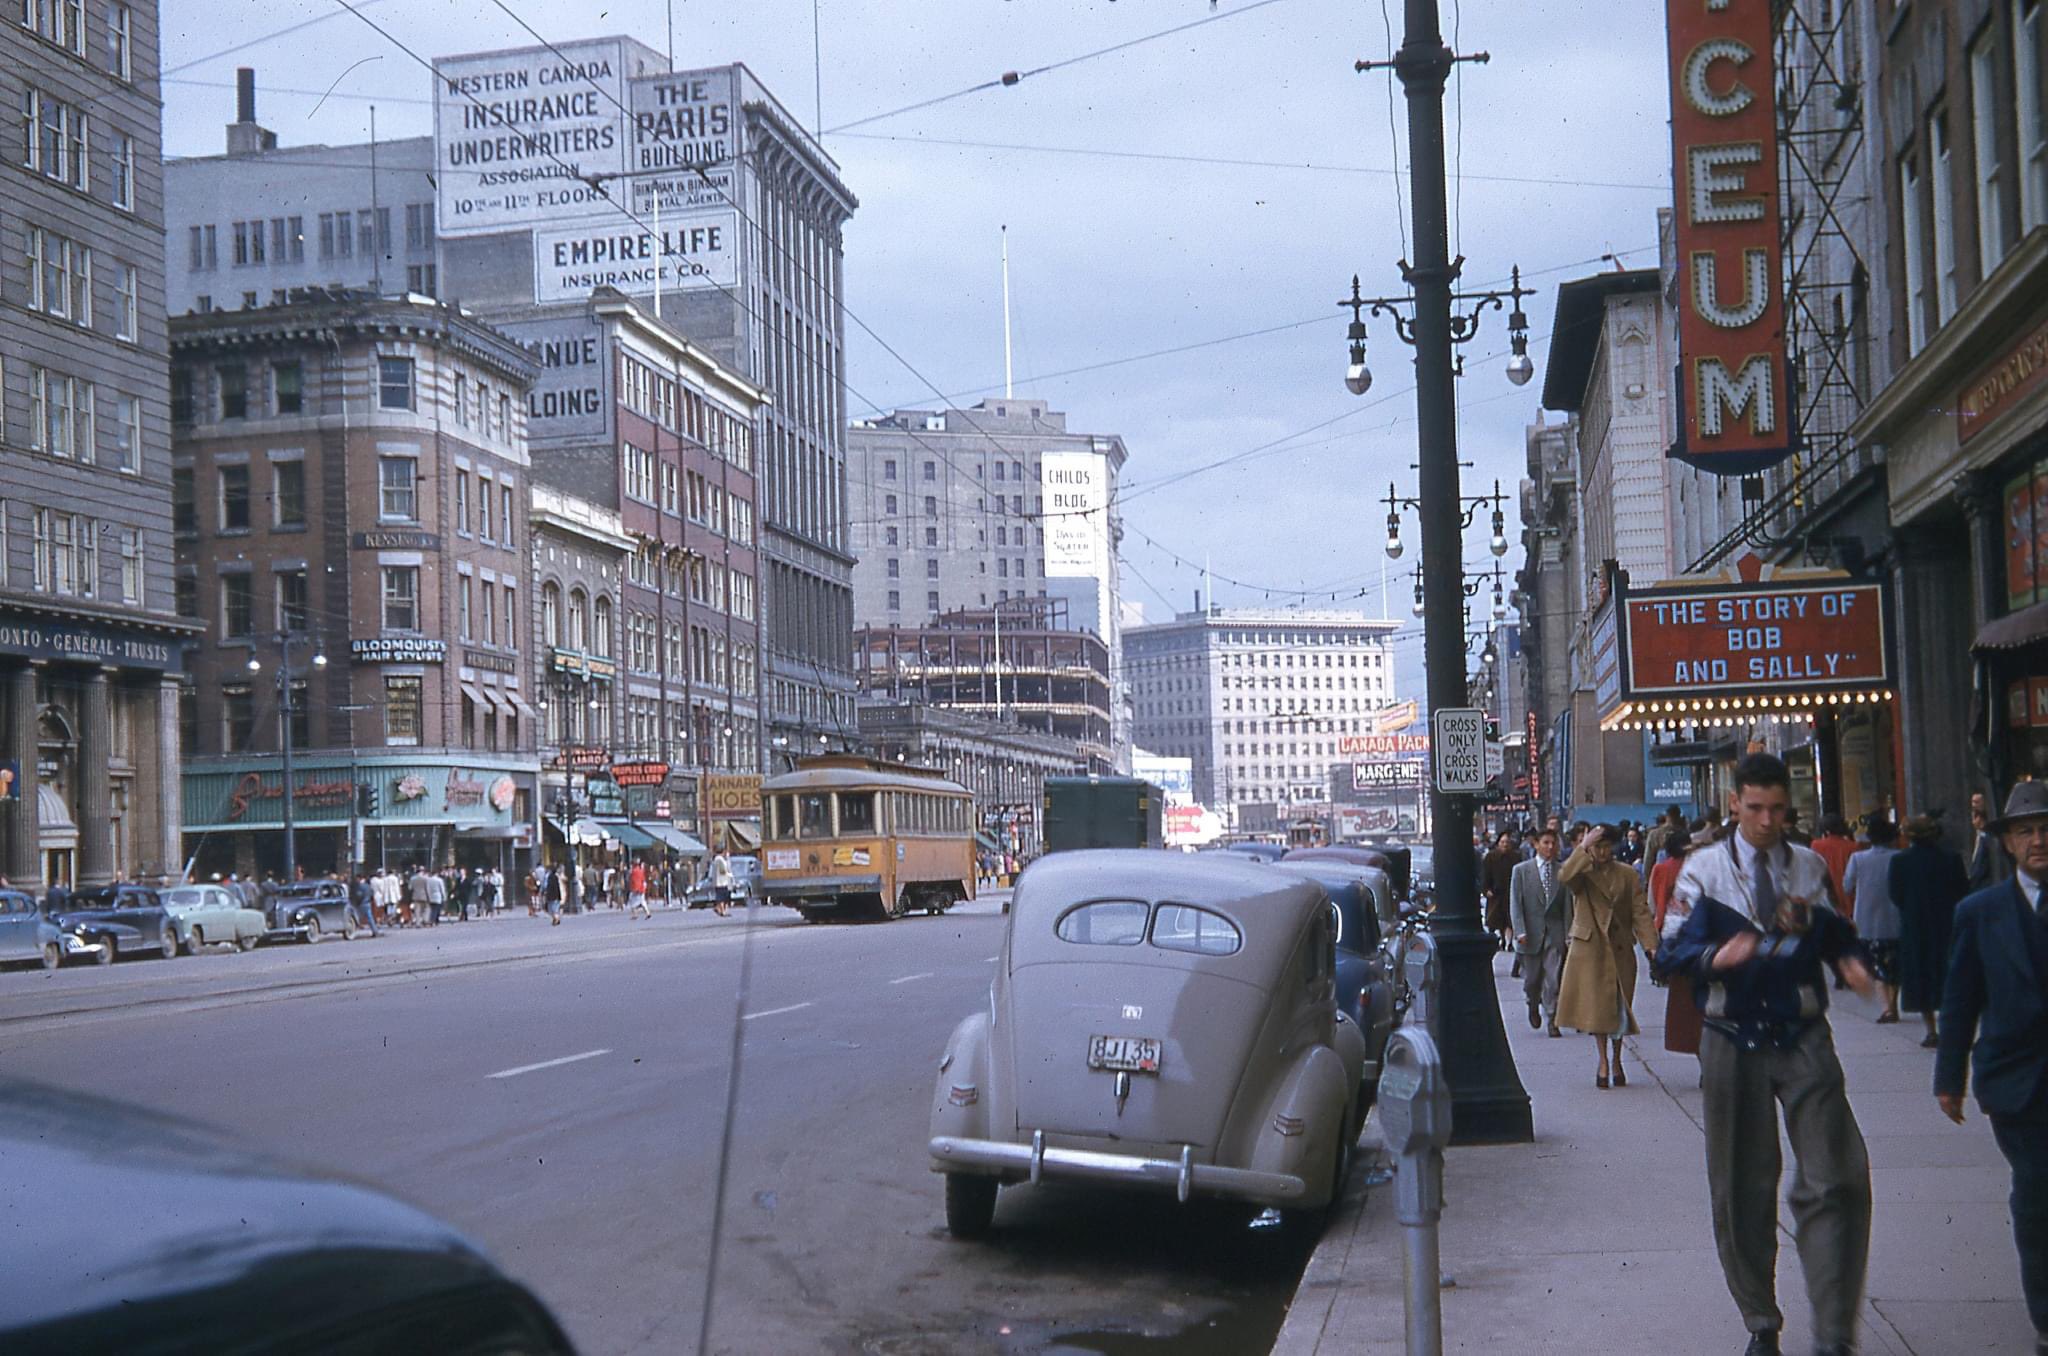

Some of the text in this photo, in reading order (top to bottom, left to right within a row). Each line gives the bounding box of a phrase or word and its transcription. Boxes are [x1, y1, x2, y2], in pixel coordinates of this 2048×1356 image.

[448, 60, 613, 96] WESTERN CANADA
[654, 80, 708, 105] THE
[463, 91, 599, 130] INSURANCE
[636, 104, 729, 143] PARIS
[450, 125, 615, 166] UNDERWRITERS
[478, 162, 580, 187] ASSOCIATION
[537, 186, 610, 207] FLOORS
[645, 196, 681, 209] RNTAL
[1680, 0, 1776, 438] CEUM
[554, 226, 722, 268] EMPIRE LIFE
[562, 263, 710, 288] INSURANCE CO.
[1049, 469, 1090, 484] CHILDS
[1718, 596, 1807, 622] STORY
[1821, 593, 1856, 616] OF
[53, 633, 114, 656] GENERAL
[124, 641, 168, 662] TRUSTS
[1728, 627, 1782, 651] BOB
[362, 651, 443, 662] HAIR STYLISTS
[1675, 659, 1728, 684] AND
[1443, 719, 1477, 732] CROSS
[1341, 738, 1394, 753] CANADA
[1450, 735, 1476, 748] ONLY
[1456, 748, 1467, 756] AT
[1356, 763, 1419, 780] MARGENE
[1445, 755, 1478, 768] CROSS
[1446, 770, 1478, 783] WALKS
